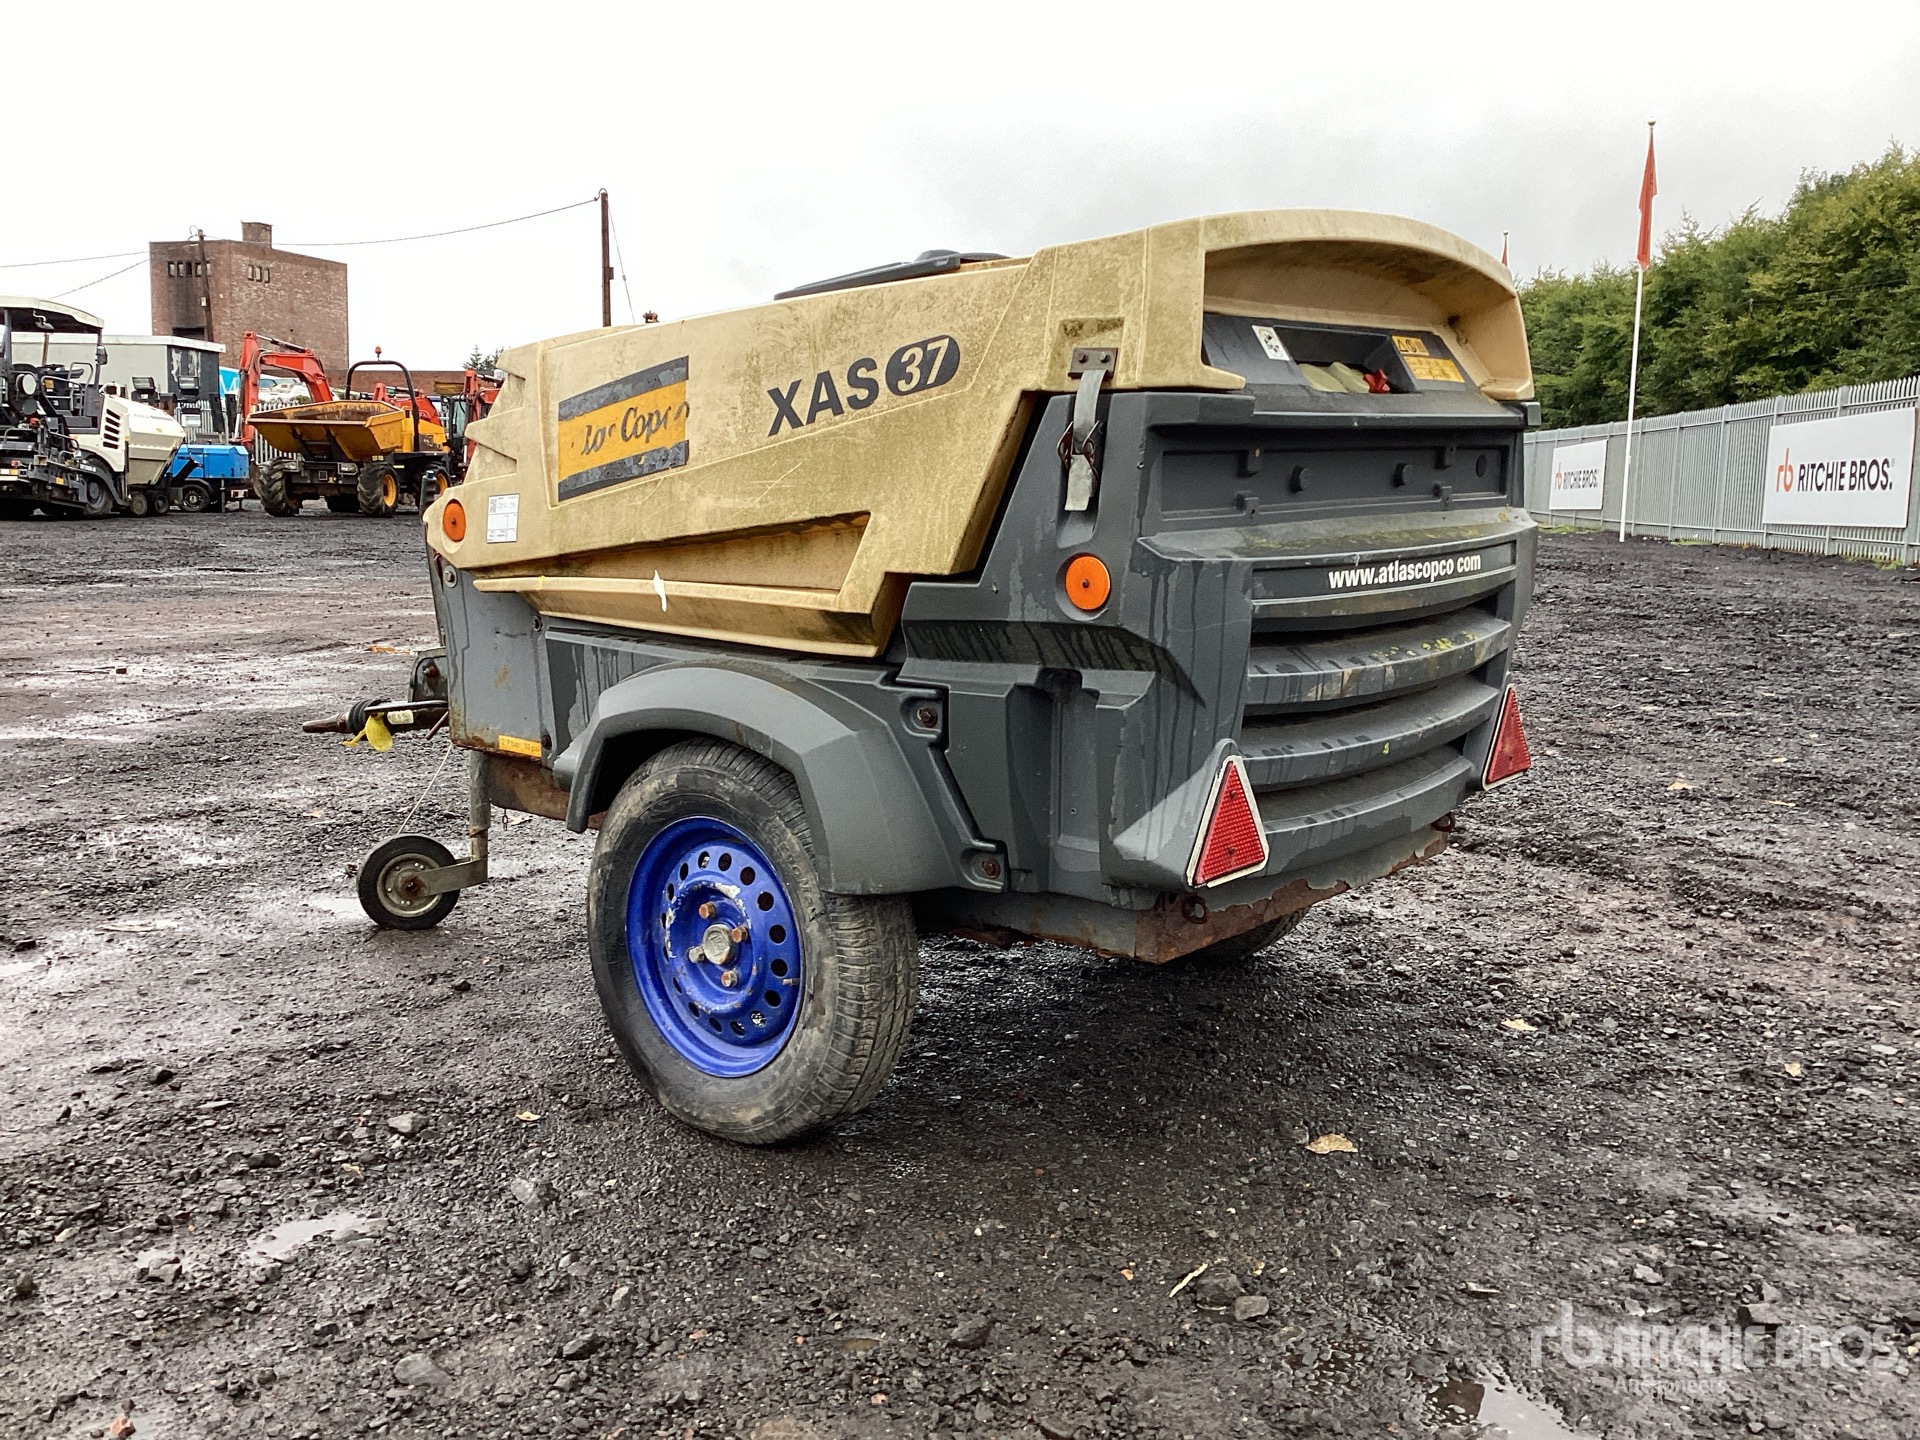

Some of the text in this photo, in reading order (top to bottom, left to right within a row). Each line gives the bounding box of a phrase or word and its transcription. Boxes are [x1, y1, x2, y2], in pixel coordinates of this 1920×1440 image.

[767, 337, 950, 437] XAS 37
[1798, 461, 1847, 492] RITCHIE
[1848, 458, 1893, 491] BROS.
